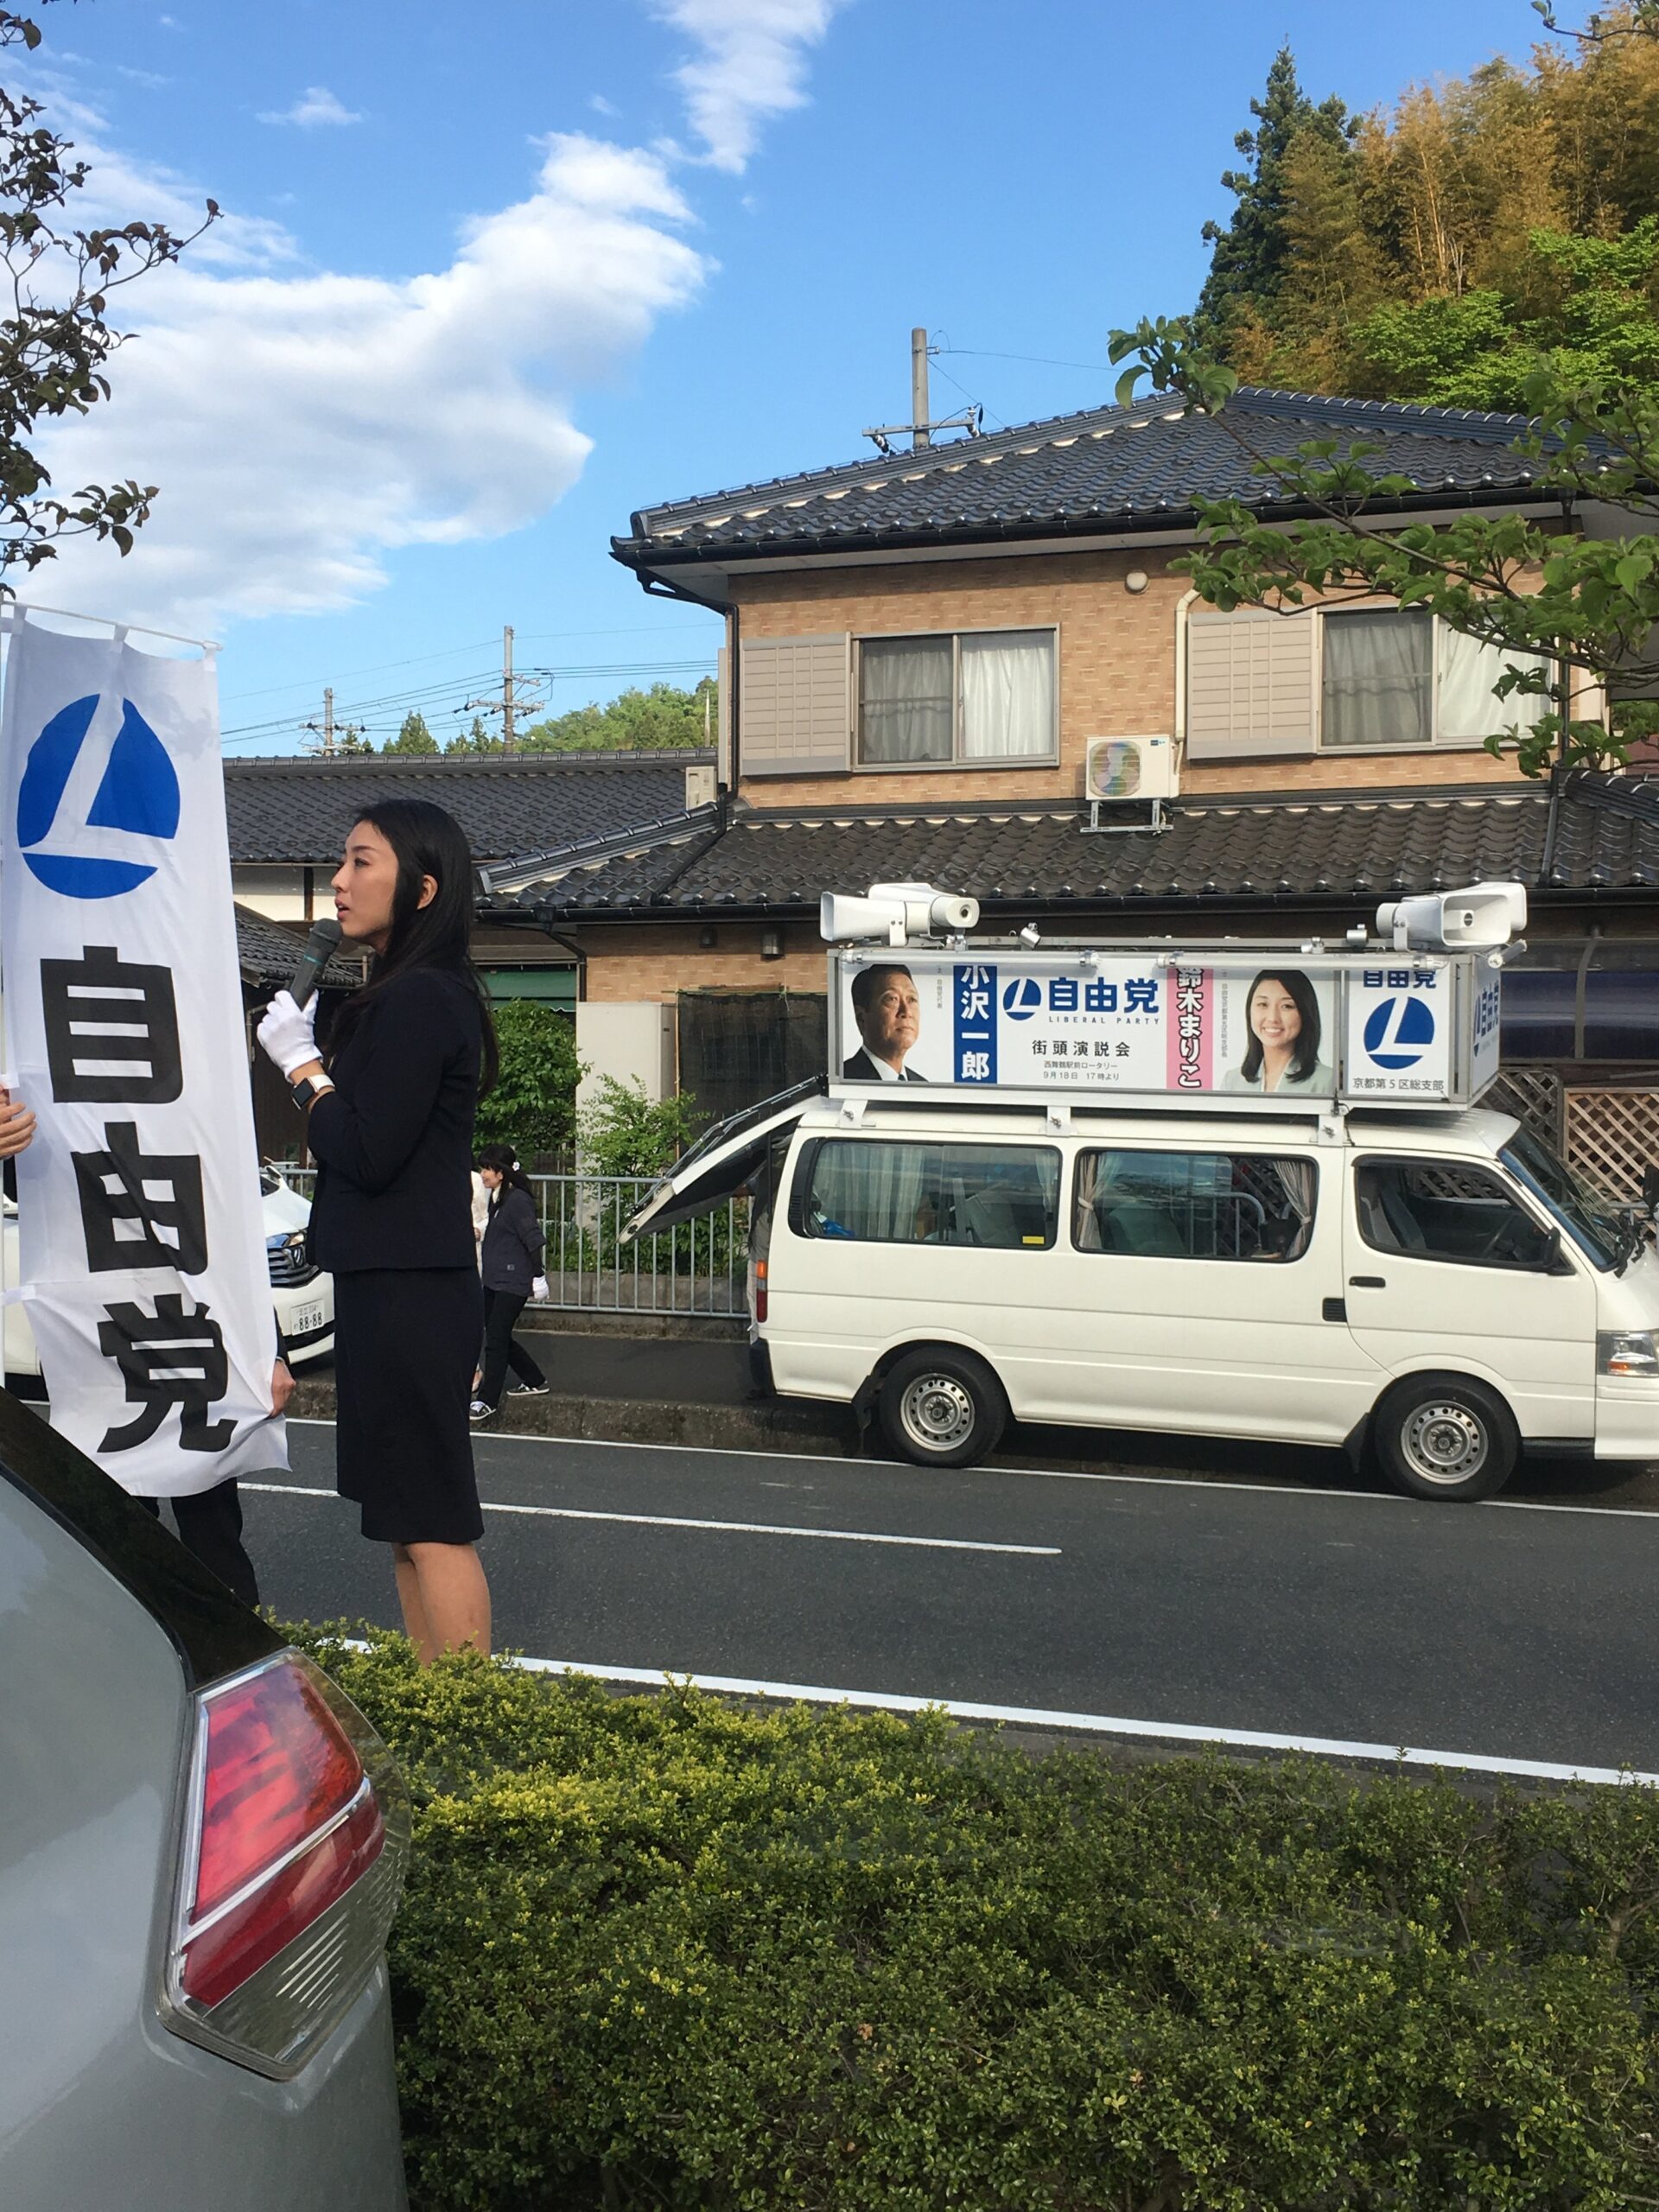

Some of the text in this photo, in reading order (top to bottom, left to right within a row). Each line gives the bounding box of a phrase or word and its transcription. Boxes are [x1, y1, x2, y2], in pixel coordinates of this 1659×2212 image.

[961, 965, 990, 1081] 小沢一郎
[1032, 1039, 1130, 1057] 街頭演説会
[1049, 976, 1160, 1014] 自由党
[1176, 969, 1205, 1088] 鈴木まりこ
[40, 945, 238, 1453] 自由党
